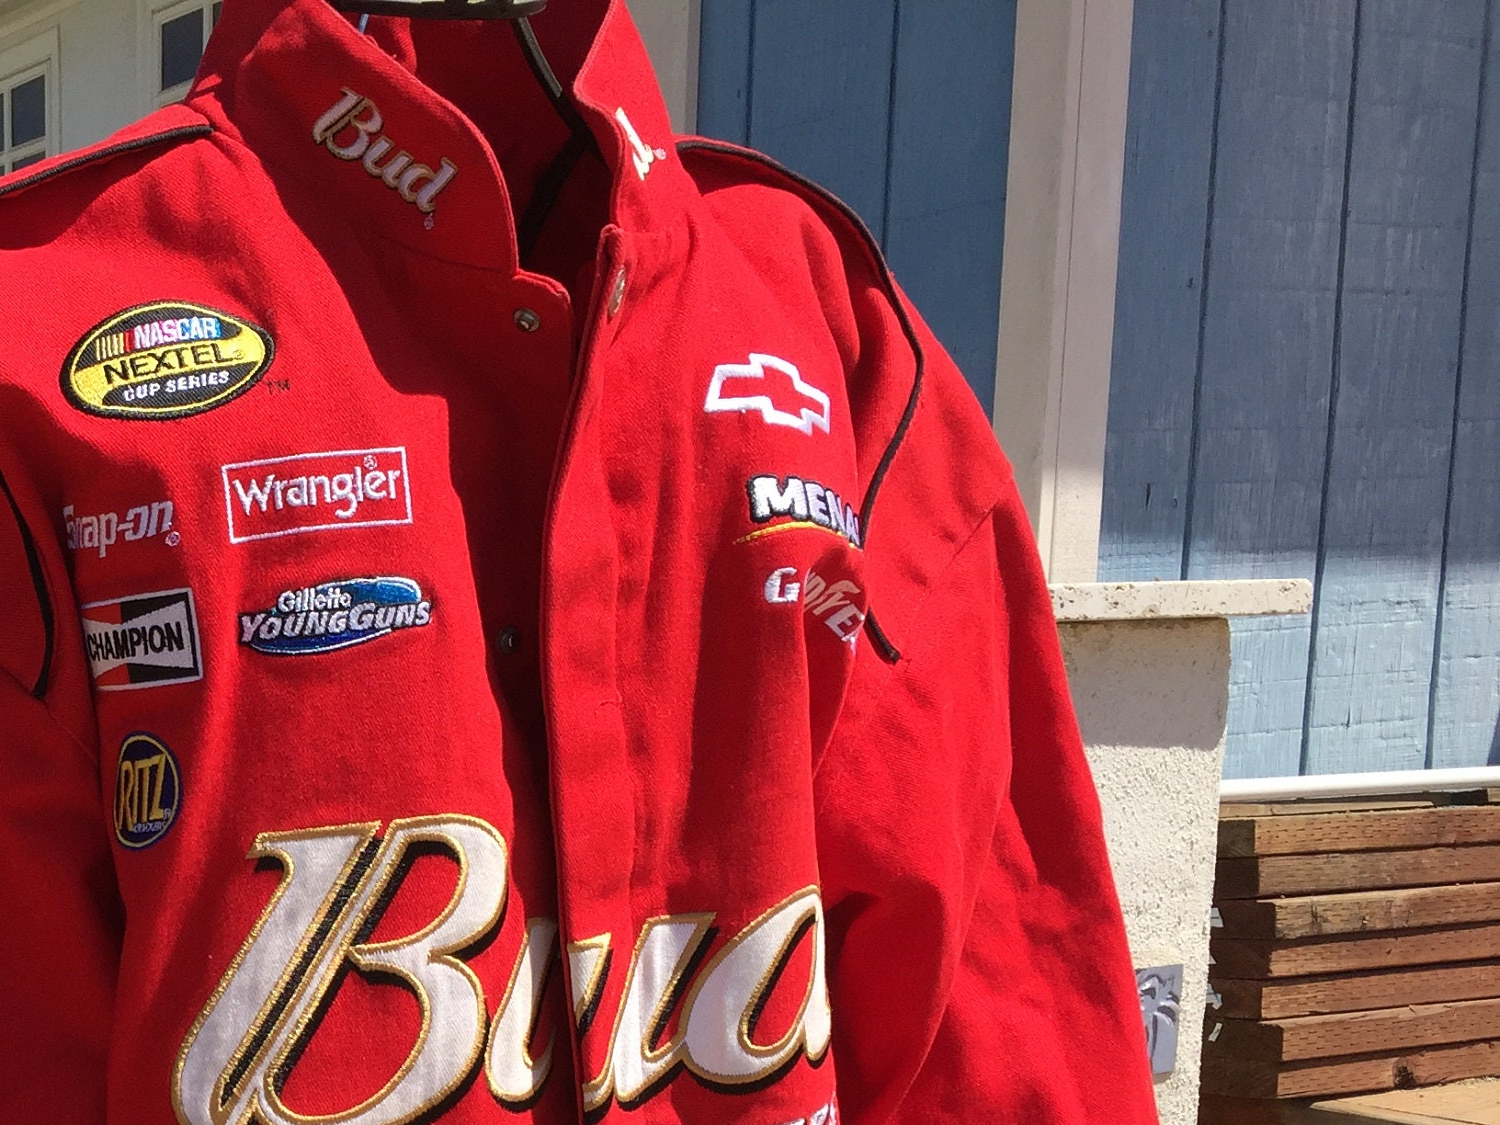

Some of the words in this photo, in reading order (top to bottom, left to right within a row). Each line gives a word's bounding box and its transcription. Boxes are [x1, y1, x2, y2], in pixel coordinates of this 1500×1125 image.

[312, 86, 458, 212] Bud
[133, 316, 222, 350] NASCAR
[103, 342, 236, 385] NEXTEL
[123, 382, 161, 402] CUP
[165, 370, 230, 393] SERIES
[233, 465, 402, 519] Wrangler
[748, 474, 861, 547] MENA
[277, 587, 352, 613] Gillette
[87, 621, 185, 662] CHAMPION
[117, 753, 167, 832] RITZ
